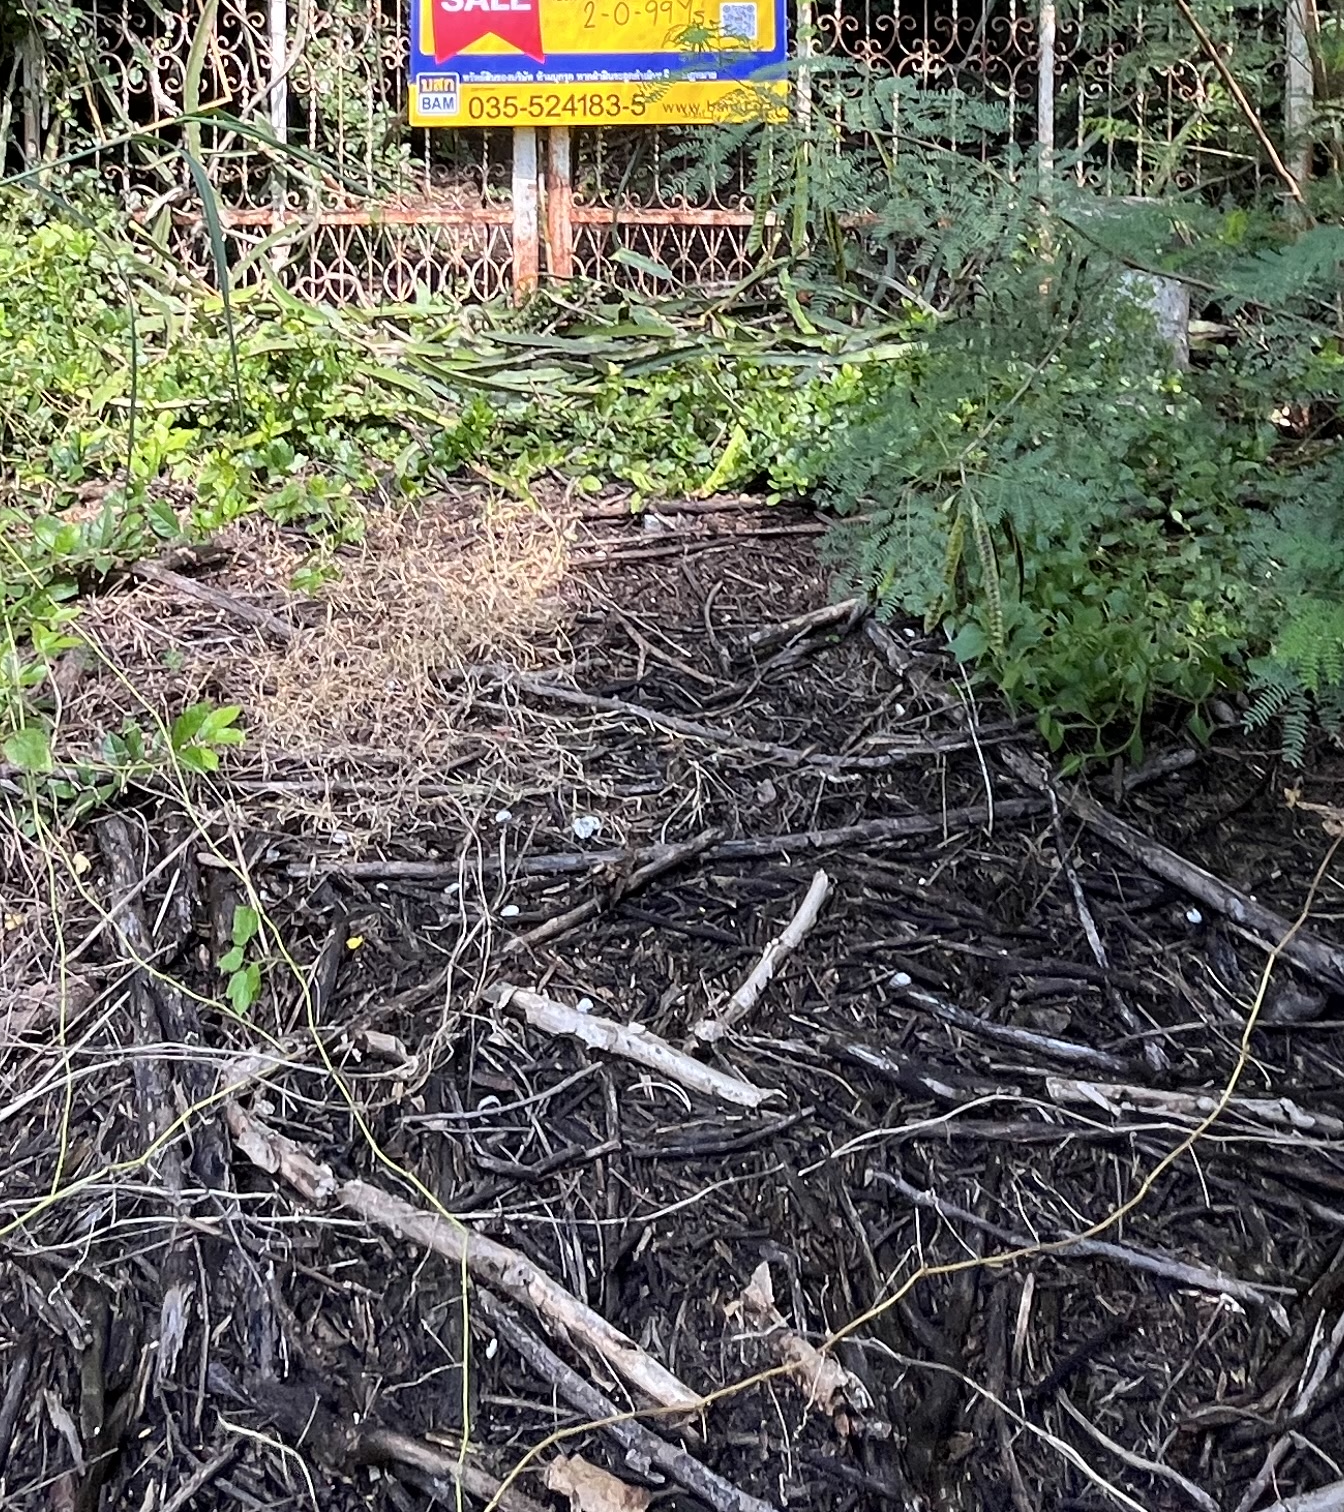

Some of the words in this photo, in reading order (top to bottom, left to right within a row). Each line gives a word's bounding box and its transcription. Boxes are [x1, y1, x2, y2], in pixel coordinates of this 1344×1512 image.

[420, 77, 455, 92] บสก
[422, 96, 454, 110] BAM
[468, 94, 647, 120] 035-524183-5
